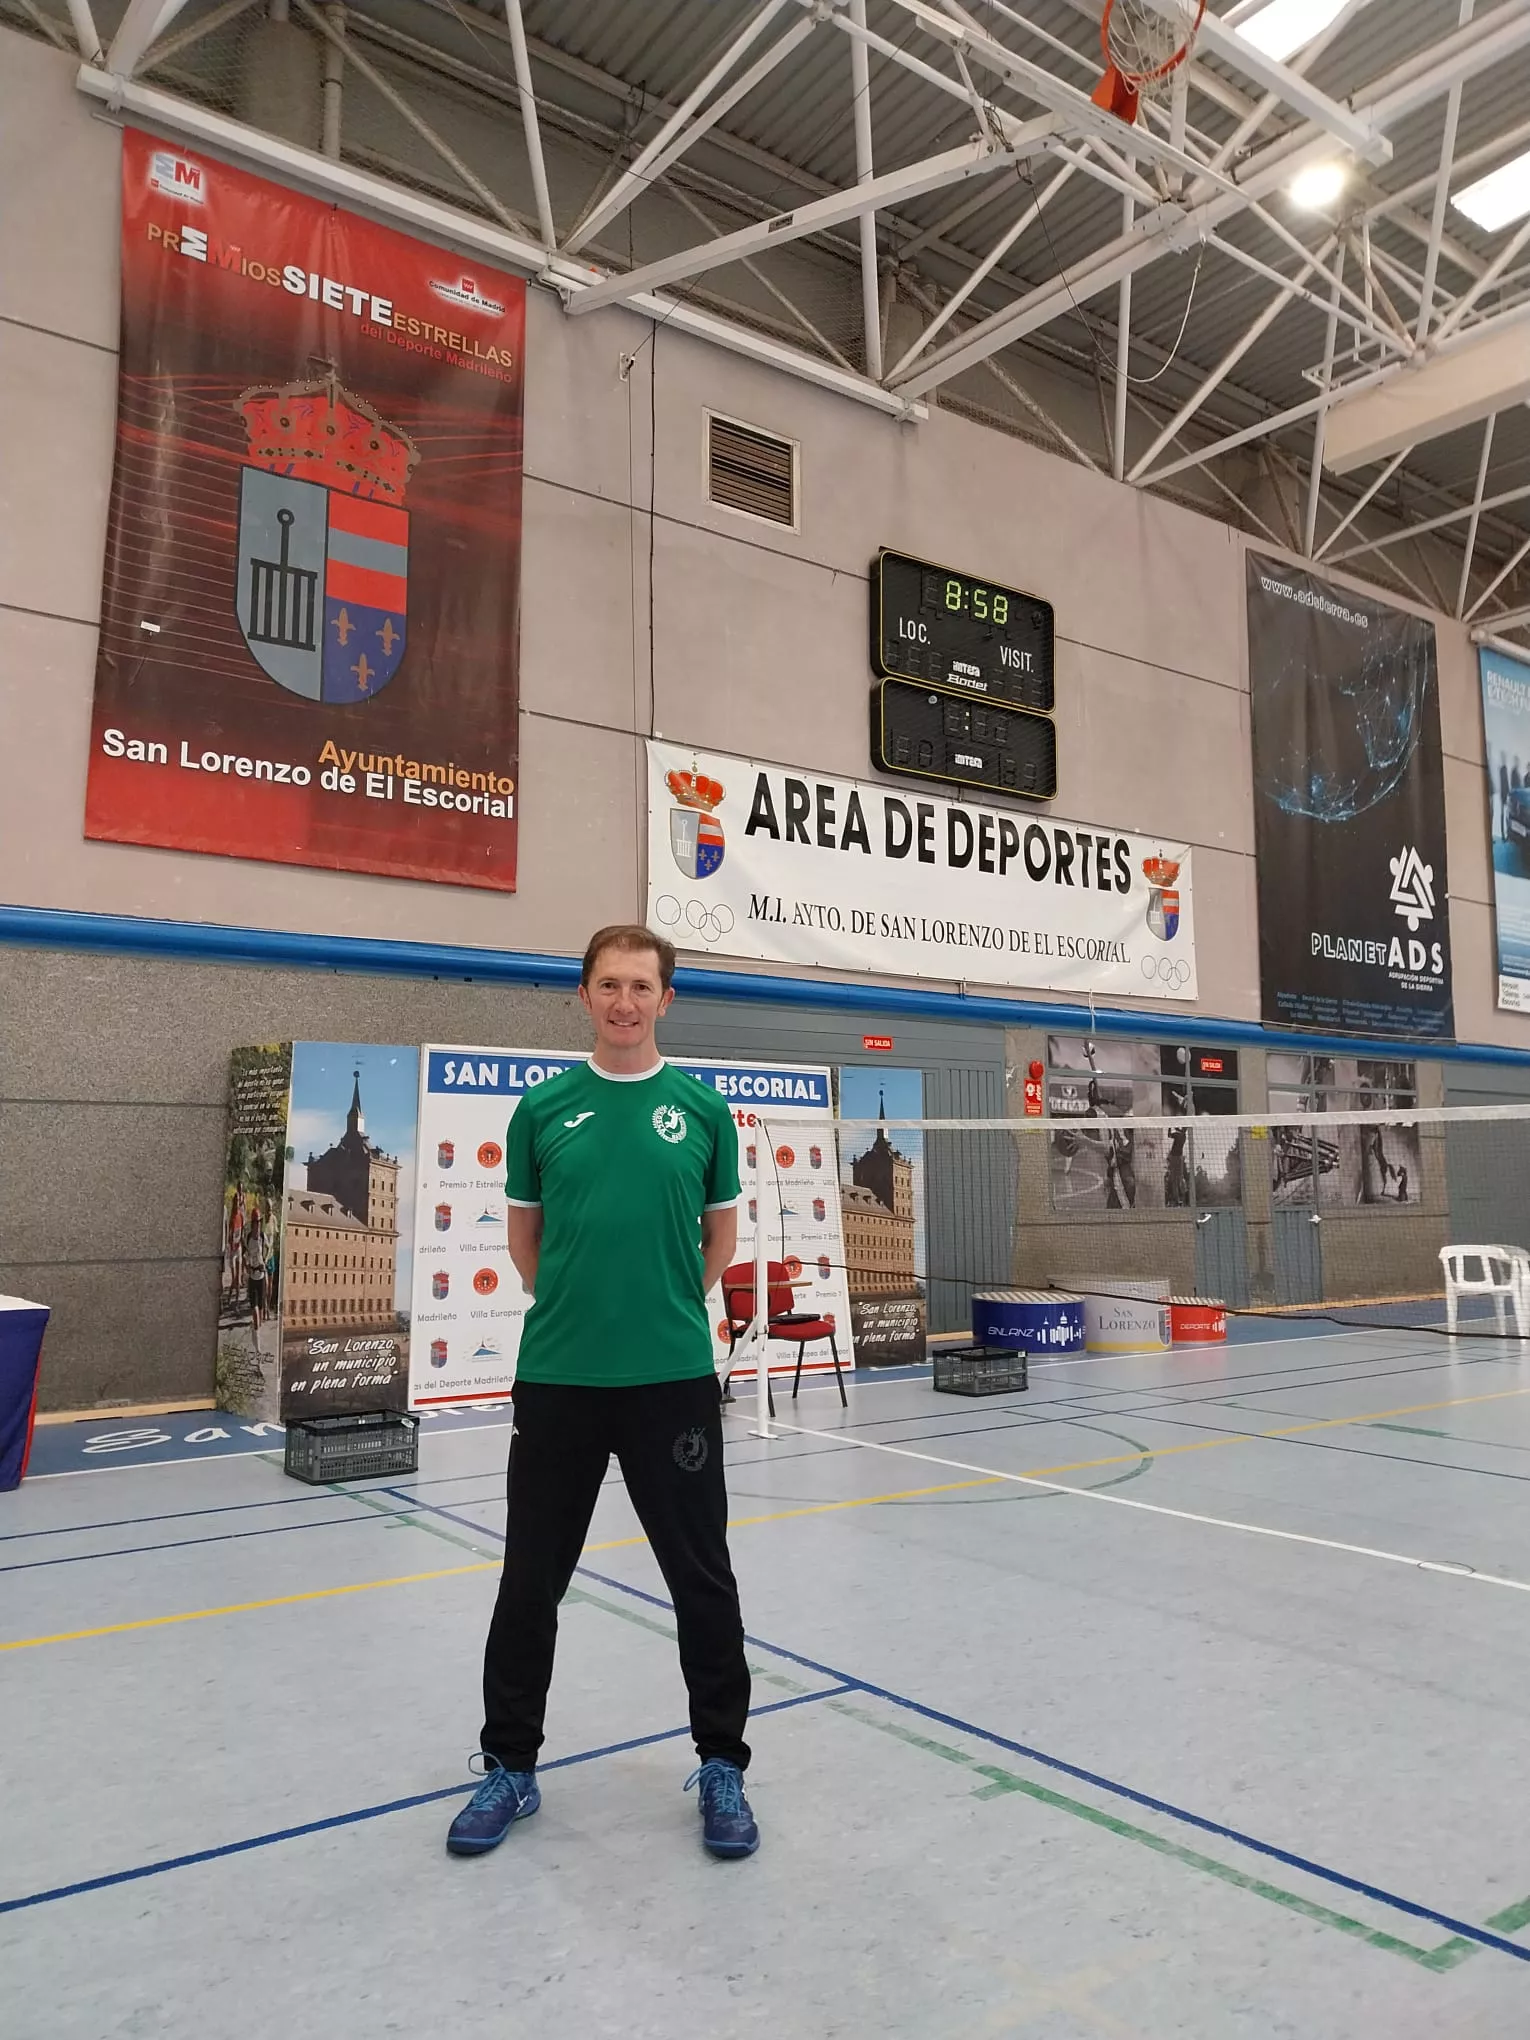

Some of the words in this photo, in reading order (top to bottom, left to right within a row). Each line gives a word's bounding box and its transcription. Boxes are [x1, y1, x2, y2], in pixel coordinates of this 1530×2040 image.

[429, 280, 469, 300] Comunidad
[471, 296, 480, 304] de
[482, 299, 506, 313] Madrid
[282, 265, 393, 327] SIETE
[393, 313, 513, 368] ESTRELLAS
[361, 321, 383, 341] del
[386, 328, 443, 360] Deporte
[445, 342, 513, 384] Madrileño
[945, 580, 1009, 626] 8:58
[899, 617, 931, 645] LOC.
[1000, 645, 1035, 673] VISIT.
[947, 673, 988, 692] Bodet
[102, 728, 168, 765] San
[180, 741, 312, 786] Lorenzo
[321, 766, 357, 794] de
[366, 772, 394, 800] El
[403, 779, 514, 820] Escorial
[318, 739, 515, 796] Ayuntamiento
[744, 772, 872, 855] AREA
[883, 796, 936, 865] DE
[947, 808, 1132, 896] DEPORTES
[746, 893, 788, 925] M.I.
[792, 902, 846, 933] AYTO.
[850, 909, 878, 936] DE
[880, 913, 918, 942] SAN
[920, 918, 1005, 952] LORENZO
[1007, 929, 1032, 955] DE
[1034, 932, 1055, 957] EL
[1056, 935, 1132, 965] ESCORIAL
[443, 1060, 499, 1087] SAN
[715, 1074, 822, 1101] ESCORIAL
[440, 1180, 467, 1189] Premio
[469, 1181, 473, 1189] 7
[801, 1233, 822, 1241] Premio
[460, 1243, 477, 1252] Villa
[815, 1290, 837, 1298] Premio
[417, 1313, 458, 1322] Madrileño
[470, 1310, 488, 1319] Villa
[490, 1309, 522, 1319] Europea
[862, 1320, 874, 1329] un
[877, 1315, 918, 1330] municipio
[862, 1332, 887, 1346] plena
[312, 1361, 330, 1373] un
[334, 1354, 397, 1372] municipio
[776, 1351, 791, 1360] Villa
[290, 1380, 307, 1393] en
[309, 1376, 348, 1395] plena
[424, 1381, 437, 1390] del
[439, 1379, 472, 1389] Deporte
[474, 1375, 513, 1385] Madrileño
